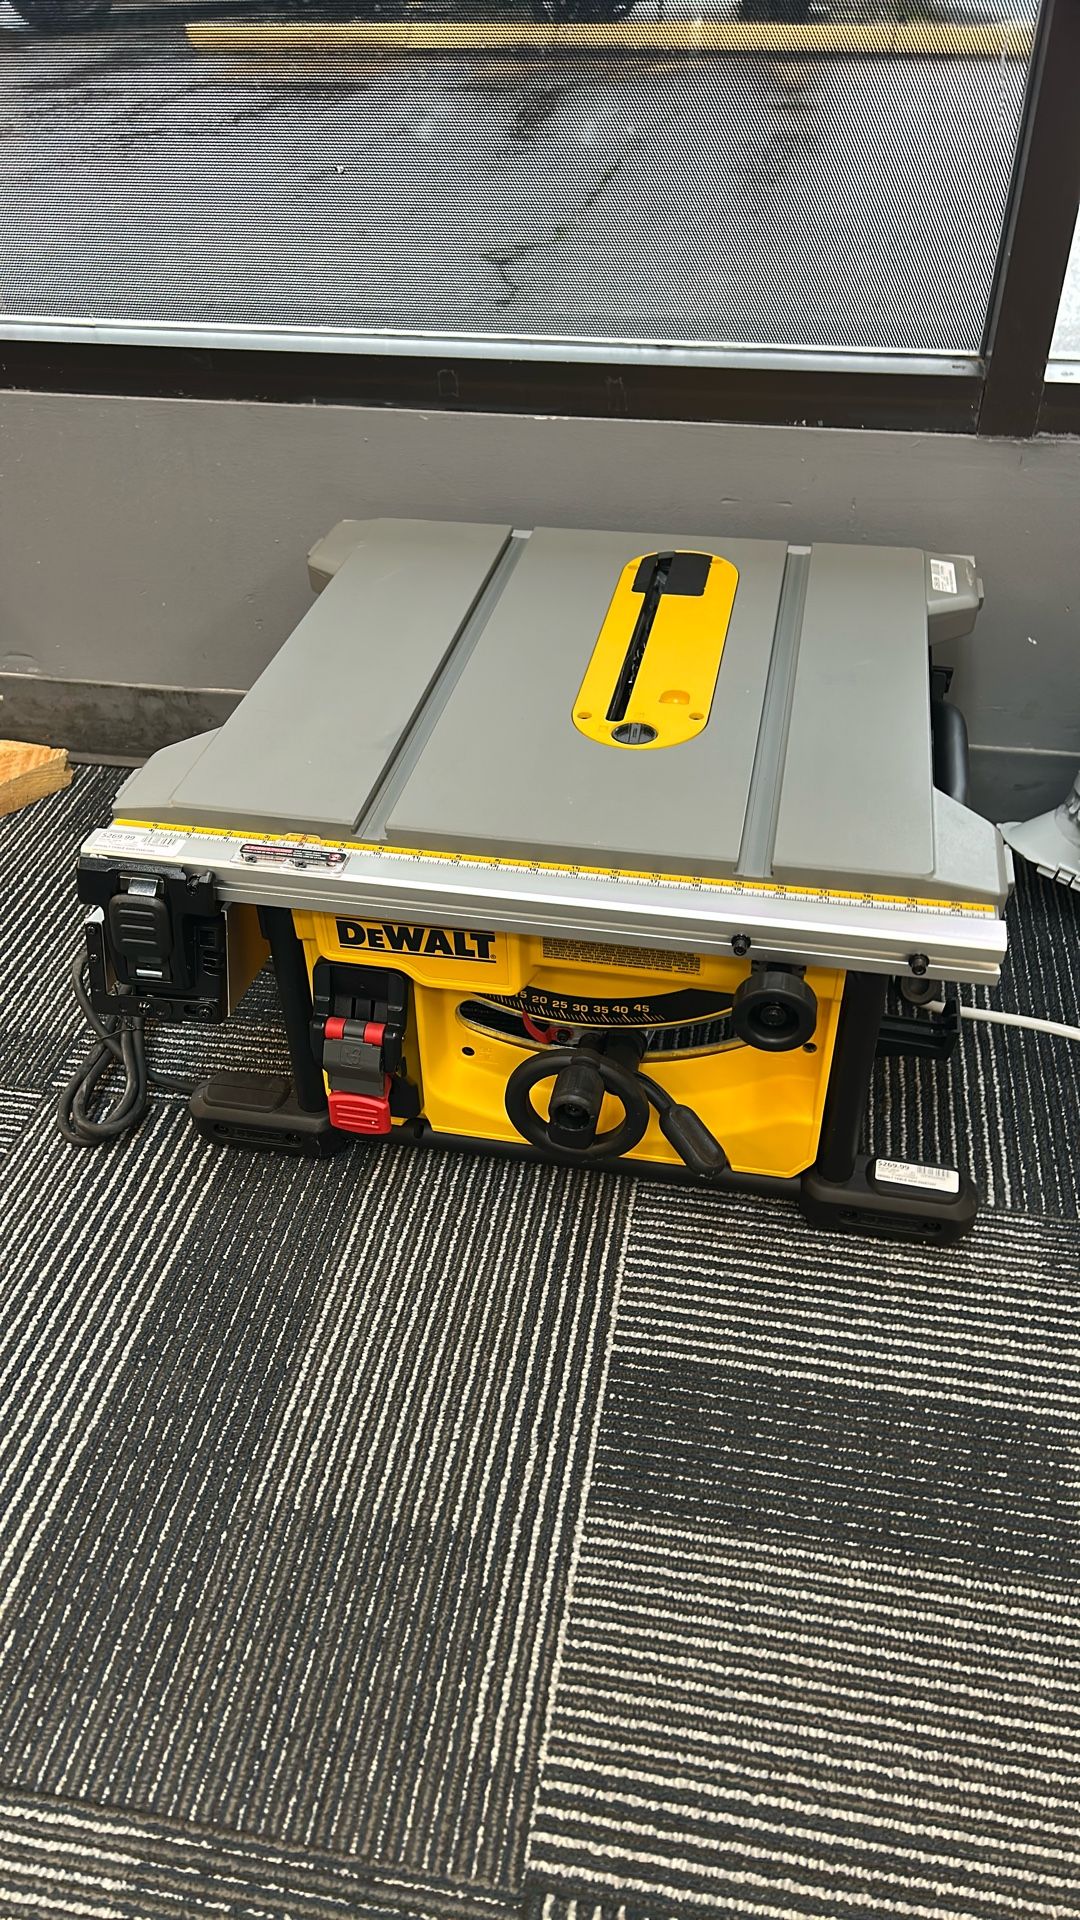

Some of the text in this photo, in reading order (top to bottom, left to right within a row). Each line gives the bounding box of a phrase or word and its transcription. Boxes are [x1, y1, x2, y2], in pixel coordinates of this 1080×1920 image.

[336, 921, 496, 958] DEWALT
[532, 995, 548, 1004] 20
[552, 1000, 568, 1009] 25
[572, 1003, 589, 1012] 30
[593, 1005, 609, 1014] 35
[612, 1005, 629, 1014] 40
[633, 1004, 650, 1013] 45
[878, 1160, 910, 1170] $269.99
